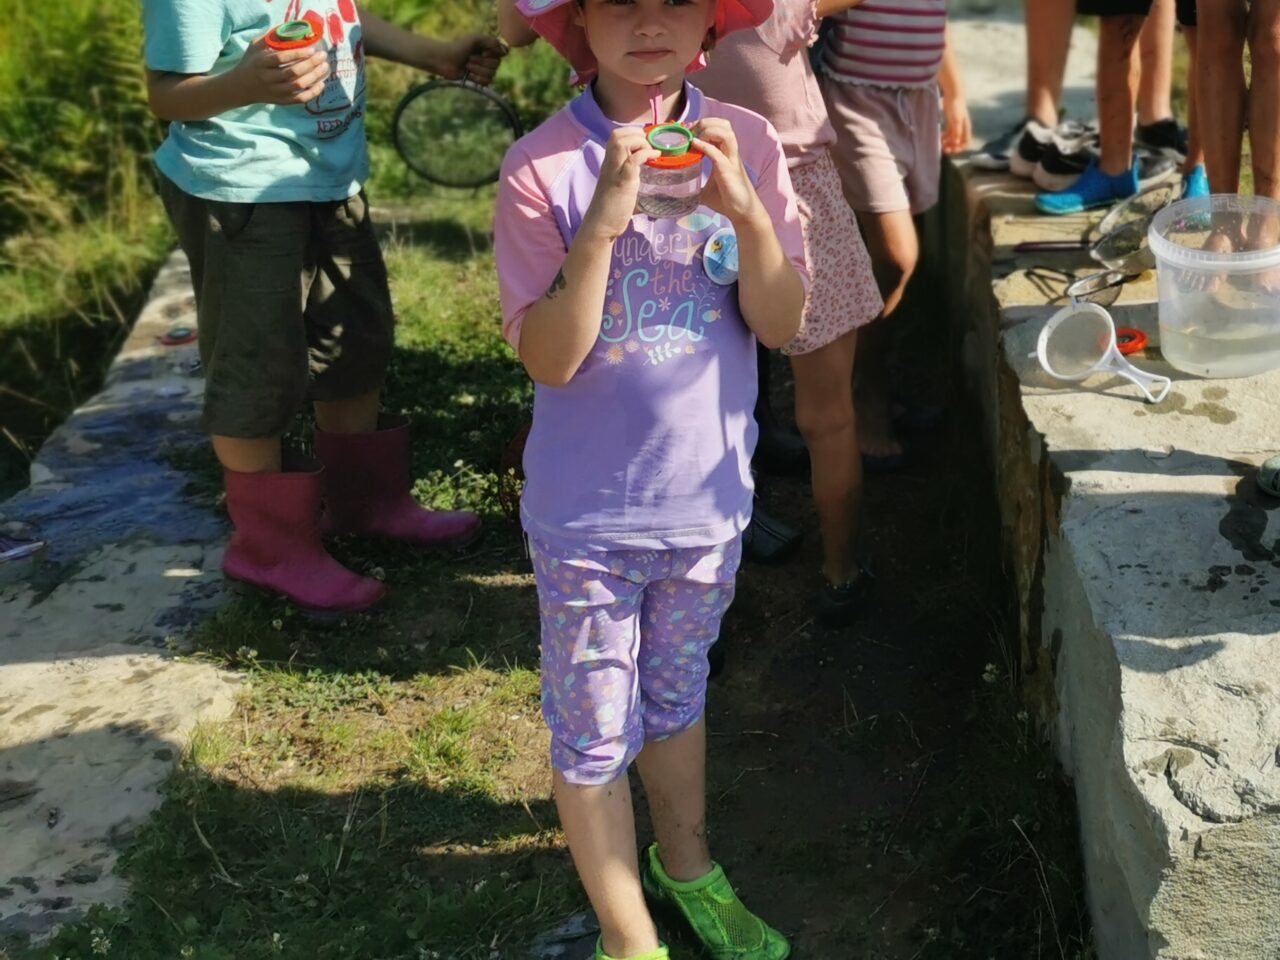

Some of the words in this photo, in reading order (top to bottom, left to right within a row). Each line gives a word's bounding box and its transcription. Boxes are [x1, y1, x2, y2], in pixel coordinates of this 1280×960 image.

[614, 221, 682, 266] under
[650, 260, 696, 296] the
[600, 268, 705, 343] Sea
